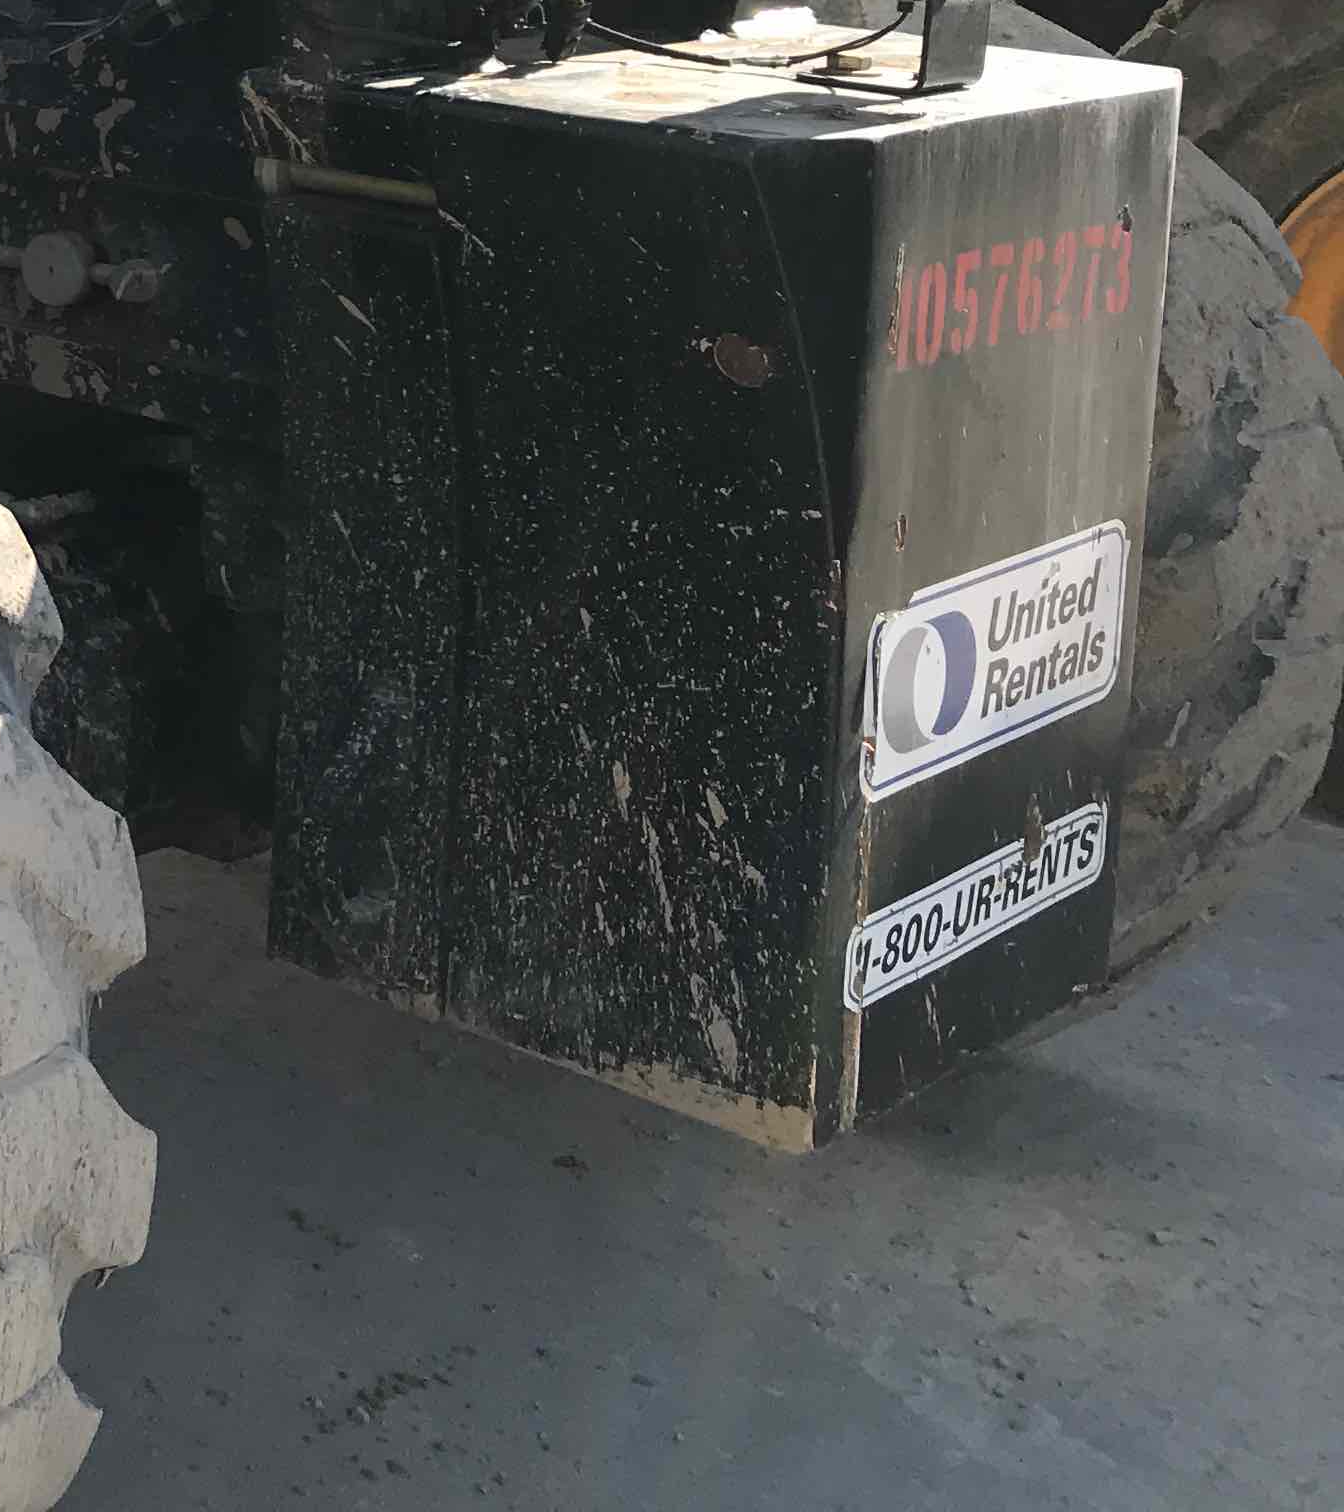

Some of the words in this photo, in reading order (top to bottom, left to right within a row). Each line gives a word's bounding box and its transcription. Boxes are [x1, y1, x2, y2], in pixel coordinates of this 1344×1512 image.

[896, 223, 1132, 372] 10576273
[987, 557, 1103, 653] United
[980, 622, 1107, 719] Rentals
[855, 822, 1100, 985] 1-800-UR-RENTS
